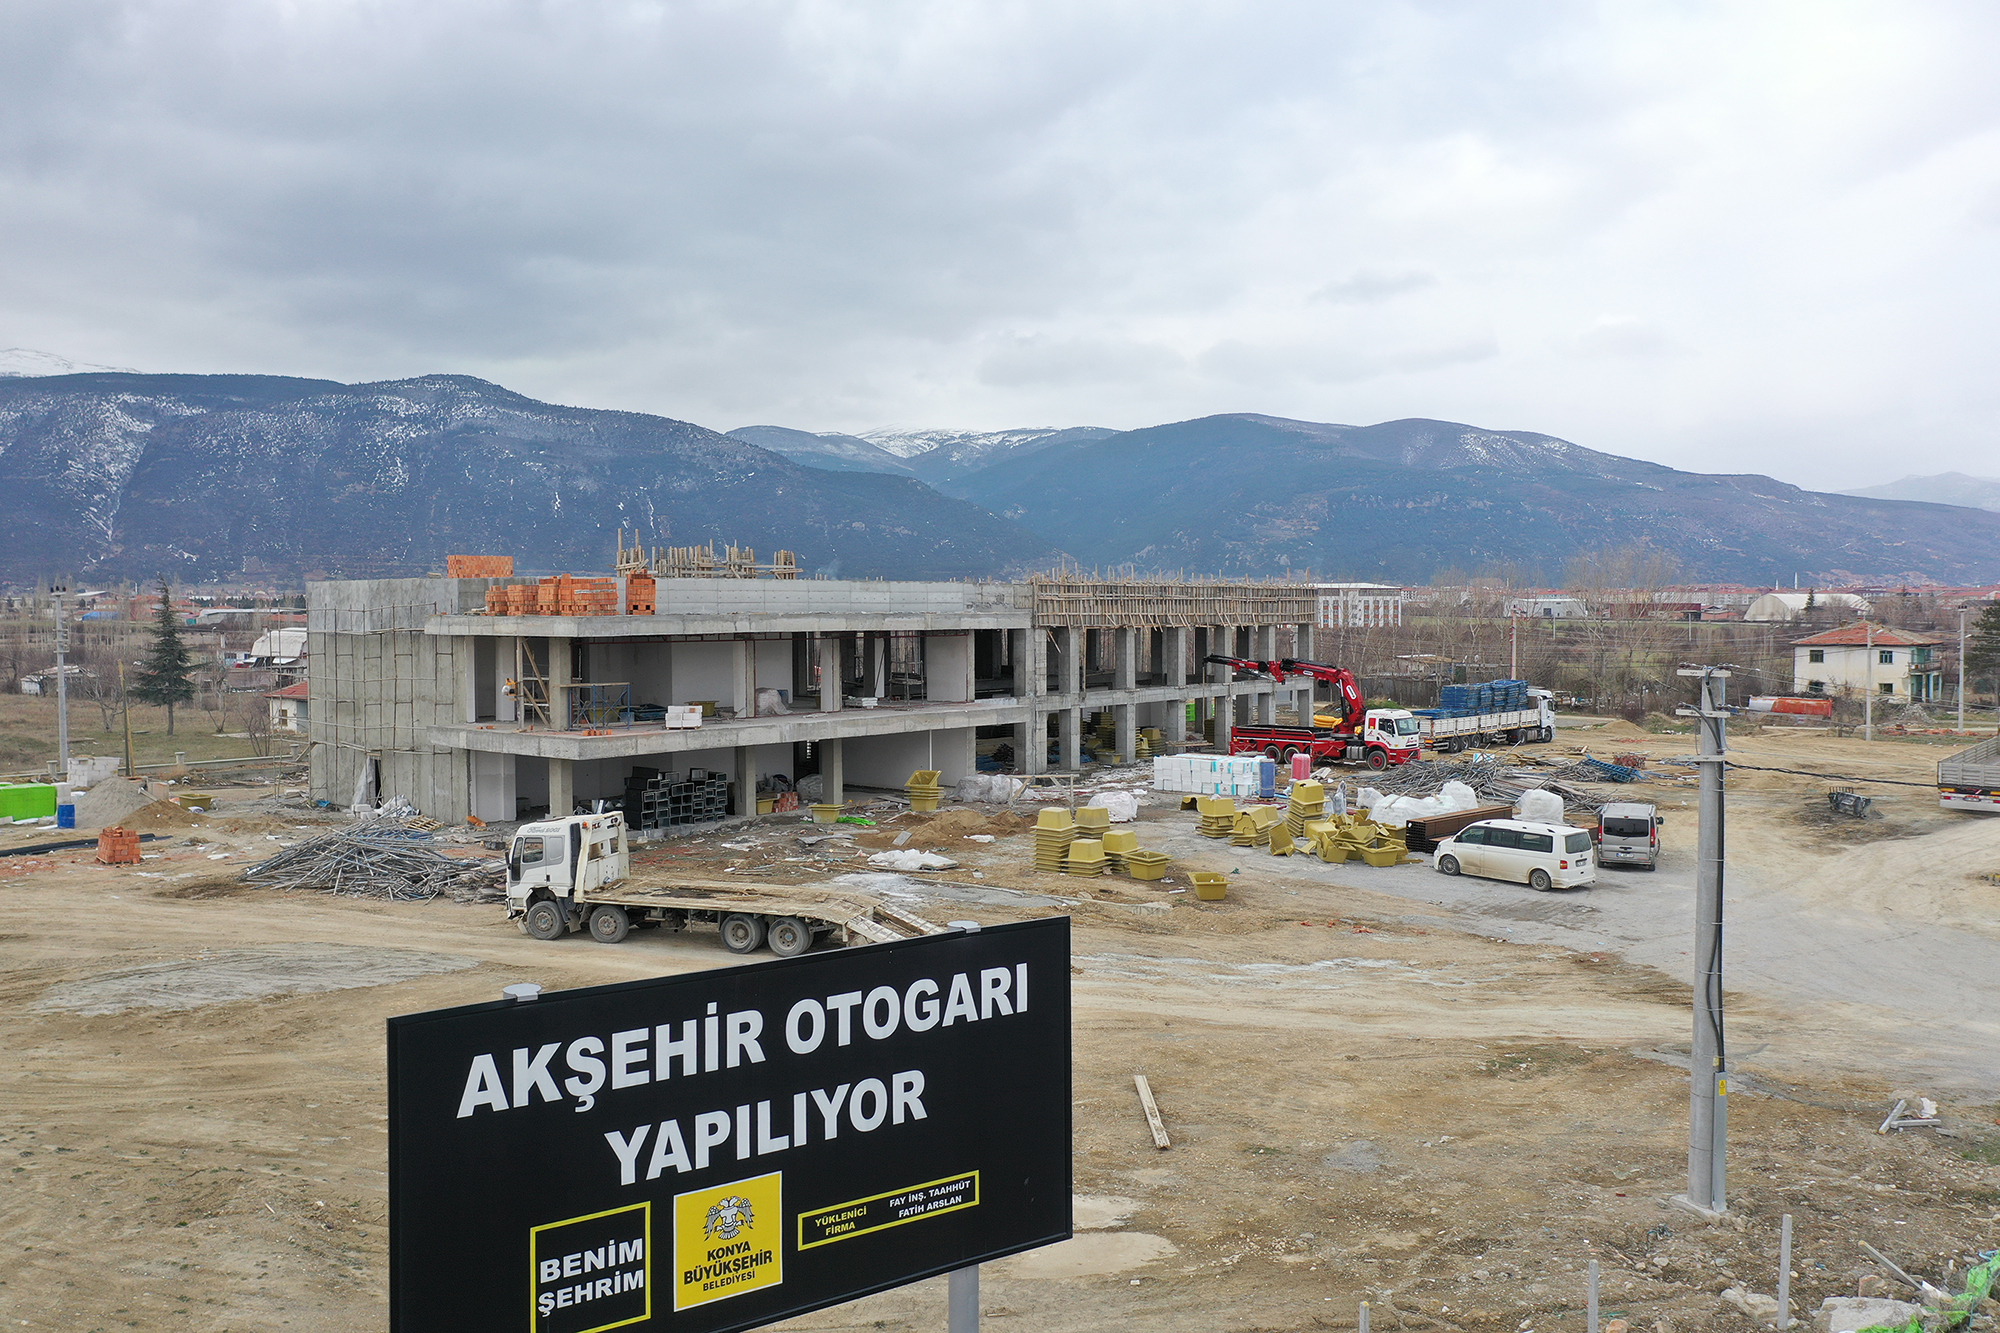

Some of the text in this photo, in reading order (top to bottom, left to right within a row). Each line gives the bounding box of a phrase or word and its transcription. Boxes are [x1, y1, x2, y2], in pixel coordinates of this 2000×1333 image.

[456, 962, 1028, 1119] AKŞEHİR OTOGARI
[603, 1069, 928, 1186] YAPILIYOR
[889, 1179, 971, 1208] FAY İNŞ. TAAHHÜT
[898, 1194, 962, 1218] FATİH ARSLAN
[814, 1205, 867, 1227] YÜKLENİCİ
[825, 1221, 856, 1236] FİRMA
[540, 1237, 643, 1284] BENİM
[707, 1240, 751, 1262] KONYA
[683, 1249, 773, 1286] BÜYÜKŞEHİR
[702, 1268, 756, 1292] BELEDİYESİ
[537, 1268, 644, 1318] ŞEHRİM
